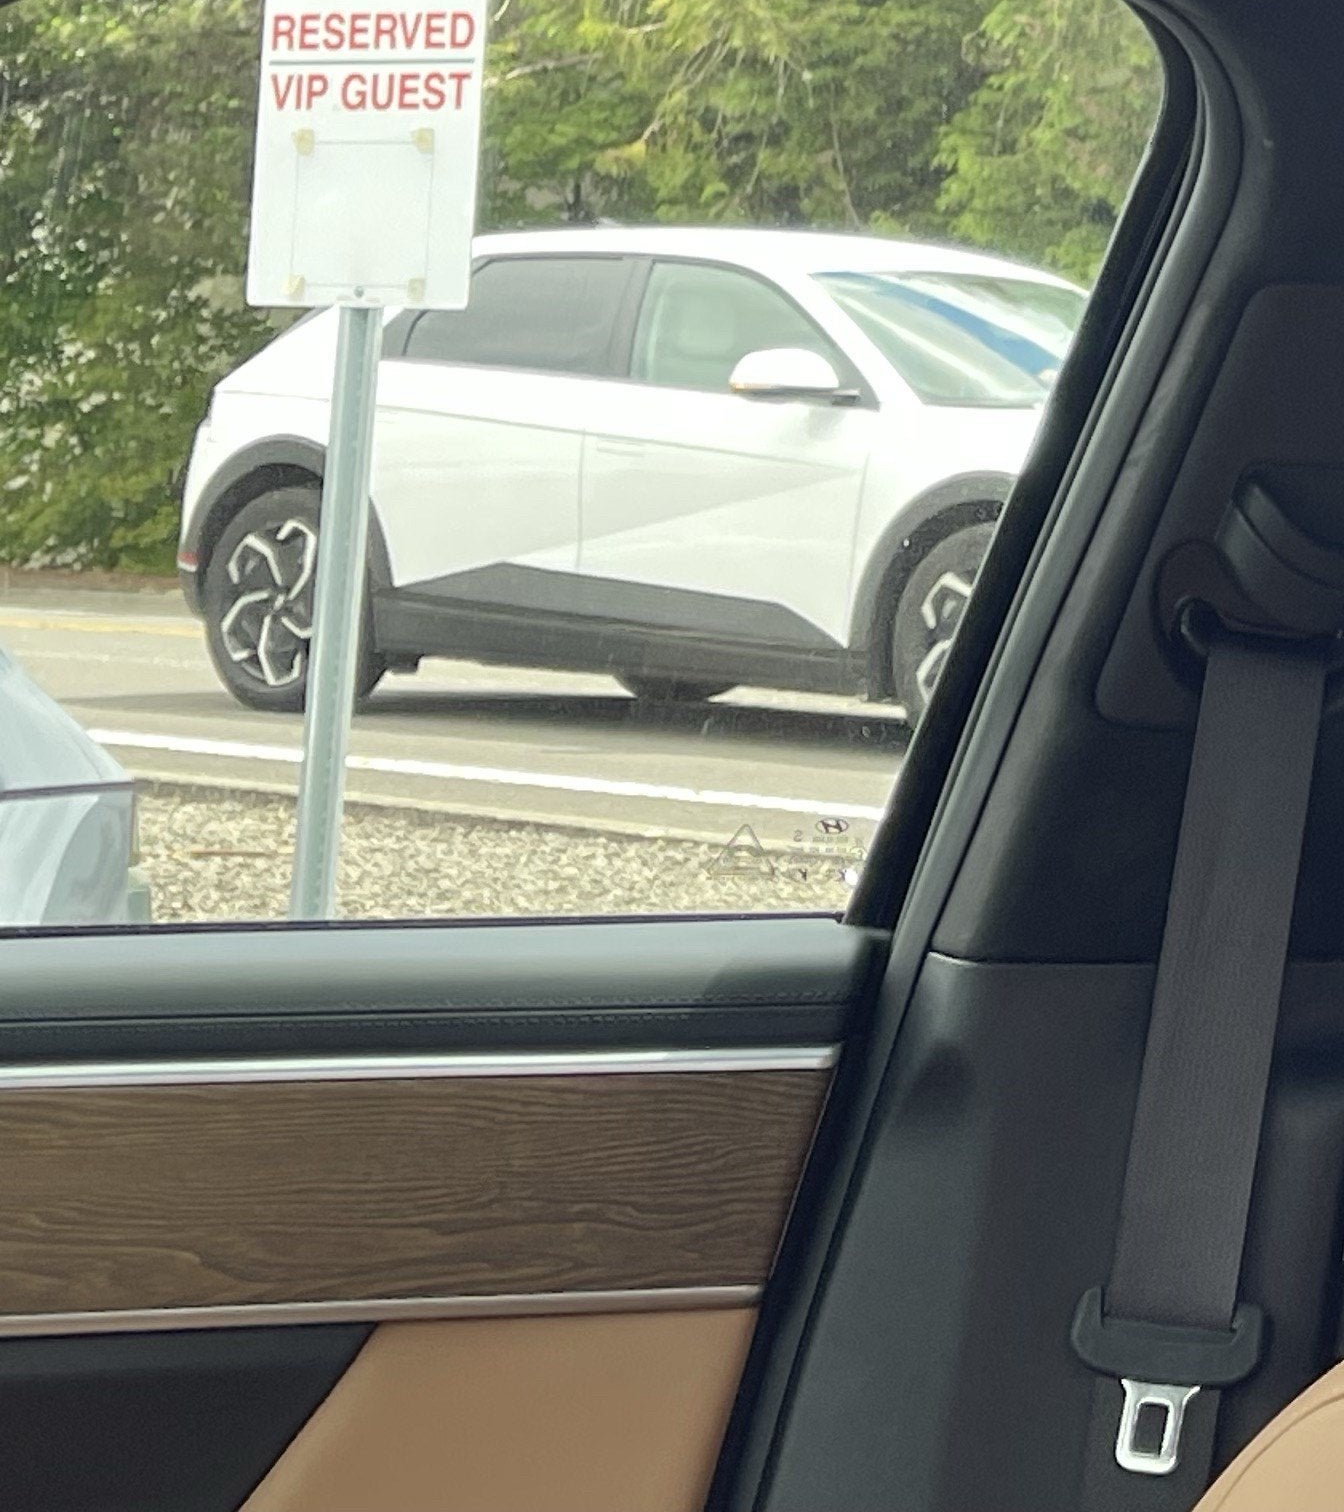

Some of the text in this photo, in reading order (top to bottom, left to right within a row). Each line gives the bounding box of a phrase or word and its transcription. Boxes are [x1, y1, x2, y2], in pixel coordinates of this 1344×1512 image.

[271, 11, 475, 51] RESERVED
[271, 72, 471, 111] VIP GUEST
